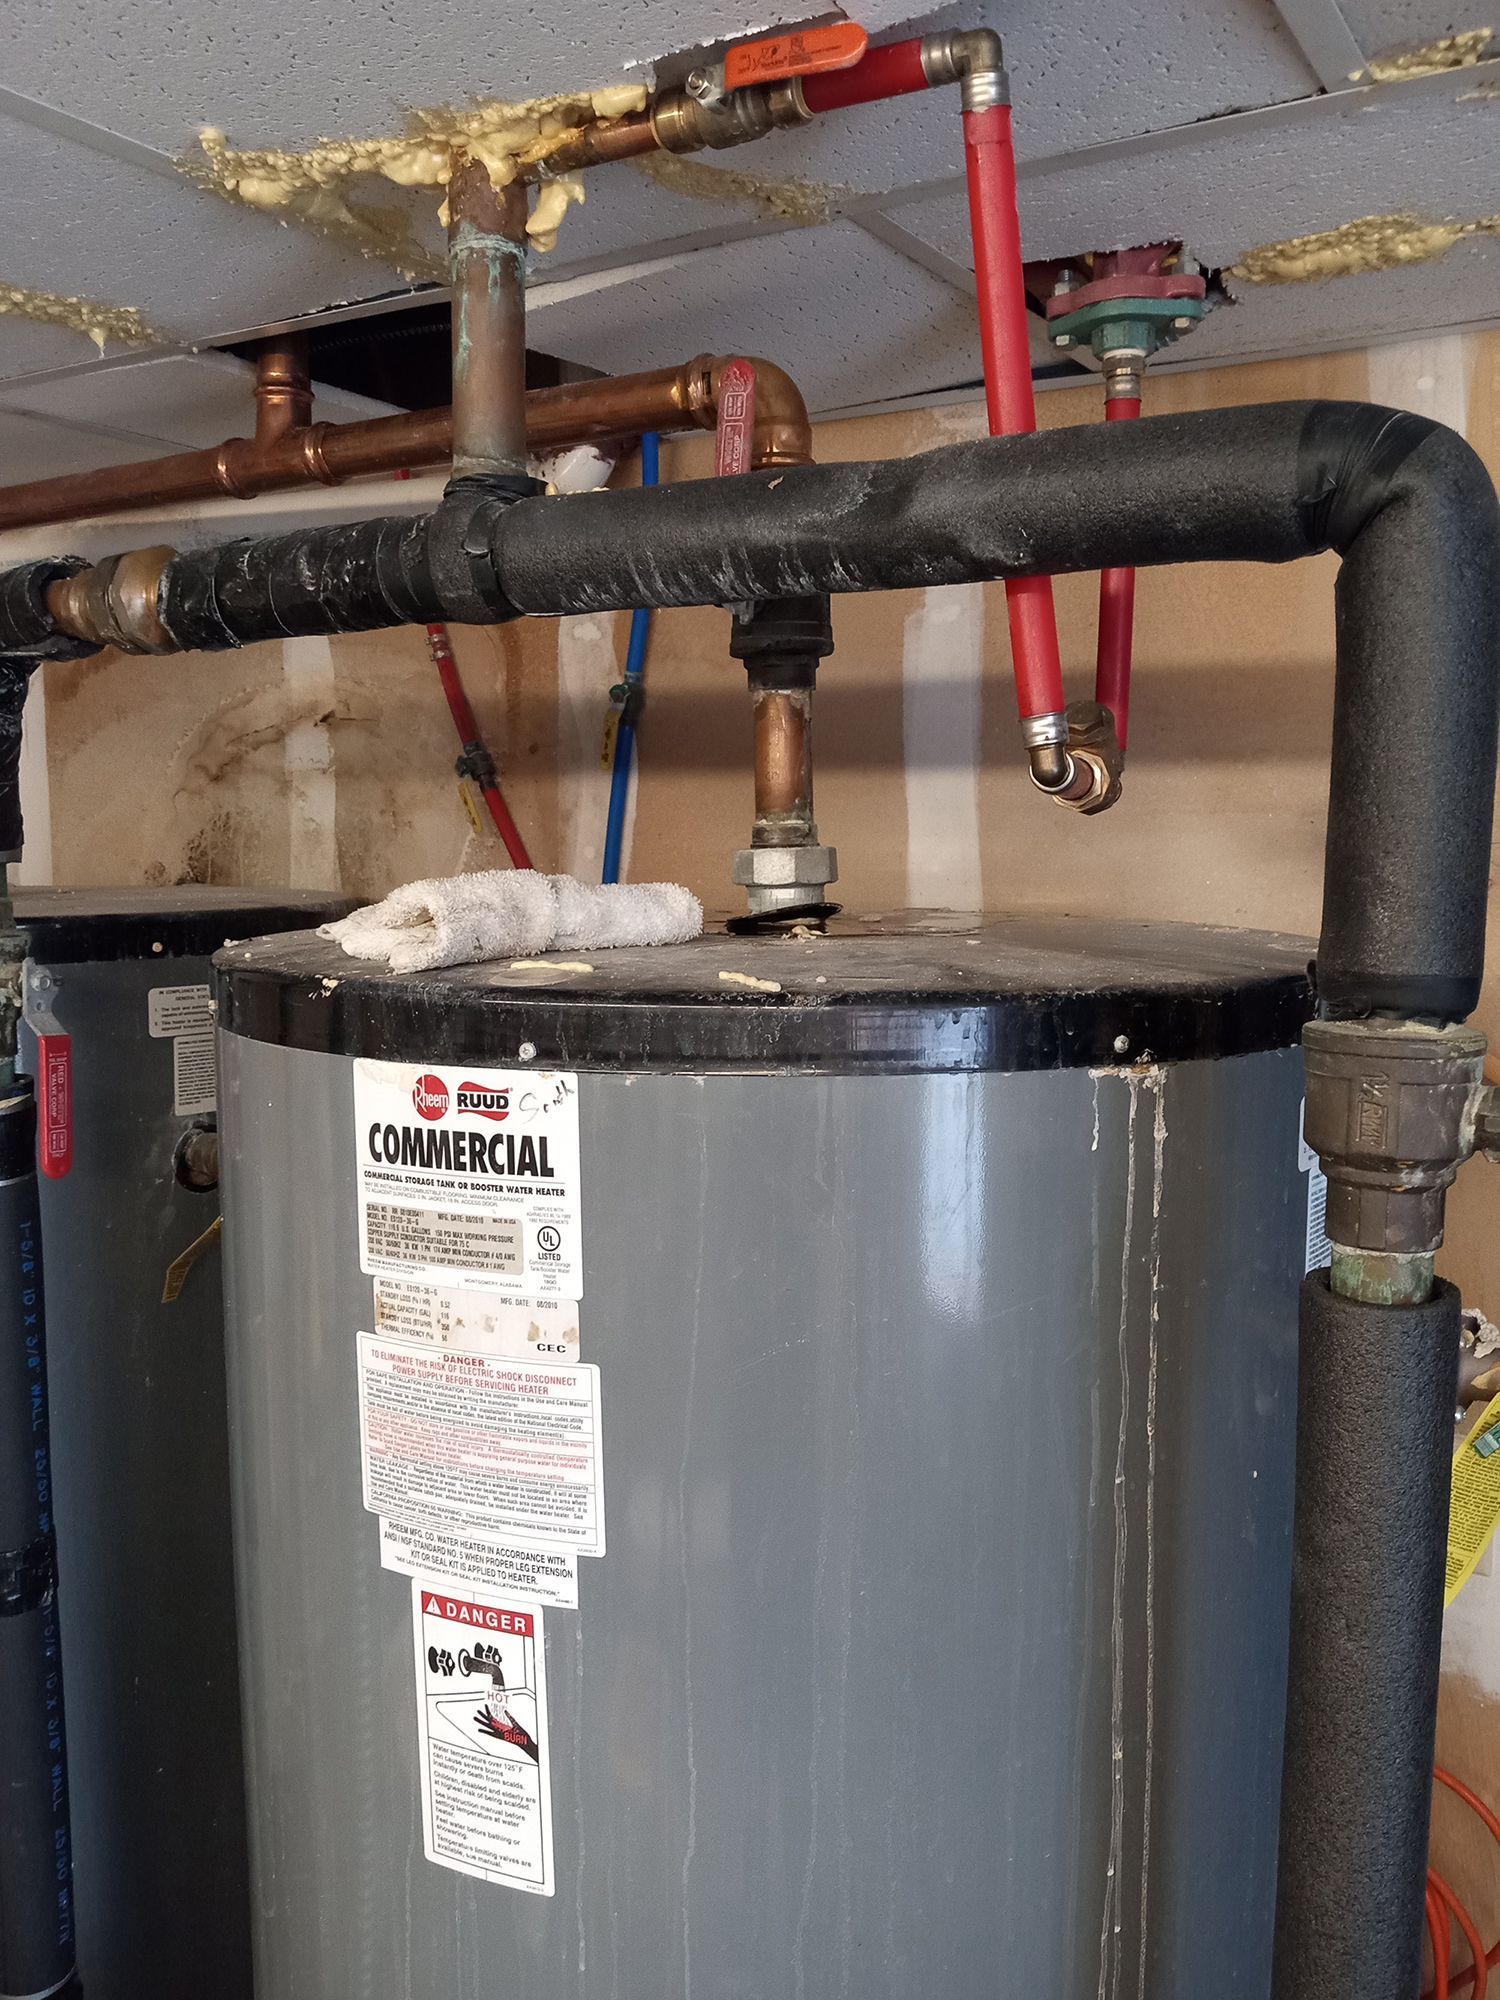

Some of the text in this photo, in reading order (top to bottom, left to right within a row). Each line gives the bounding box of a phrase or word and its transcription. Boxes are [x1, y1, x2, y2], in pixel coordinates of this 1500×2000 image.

[733, 434, 741, 459] CORP
[413, 1075, 509, 1112] Rheem RUUD
[369, 1122, 554, 1177] COMMERCIAL
[364, 1170, 565, 1197] COMMERCIAL STORAGE TANK OR BOOSTER WATER HEATER
[492, 1195, 524, 1203] CLEARANCE
[488, 1234, 514, 1243] PRESSURE
[456, 1258, 485, 1268] CONDUCTOR
[462, 1249, 490, 1258] CONDUCTOR
[538, 1253, 561, 1261] LISTED
[379, 1280, 394, 1289] MODEL
[23, 1289, 35, 1305] ID
[380, 1301, 418, 1314] ACTUAL CAPACITY
[500, 1297, 514, 1306] MFG.
[24, 1313, 37, 1325] X
[380, 1323, 401, 1333] THERMAL
[536, 1343, 566, 1353] CEC
[371, 1349, 577, 1386] TO ELIMINATE THE RISK OF ELECTRIC SHOCK DISCONNECT
[443, 1354, 485, 1367] DANGER
[388, 1374, 422, 1386] INSTALLATION
[434, 1383, 465, 1394] OPERATION
[492, 1392, 520, 1402] instructions
[392, 1364, 549, 1395] POWER SUPPLY BEFORE SERVICING HEATER
[31, 1383, 43, 1431] WALL
[384, 1531, 573, 1579] ANSI NSF STANDARD NO. 5 WHEN PROPER LEG EXTENSION
[389, 1521, 566, 1566] RHEEM MFG. CO. WATER HEATER IN ACCORDANCE WITH
[411, 1549, 538, 1585] KIT OR SEAL KIT IS APPLIED TO HEATER.
[415, 1562, 441, 1573] EXTENSION
[458, 1573, 471, 1581] SEAL
[482, 1579, 518, 1590] INSTALLATION
[445, 1602, 526, 1633] DANGER
[487, 1692, 510, 1704] HOT
[504, 1731, 527, 1745] BURN
[432, 1743, 449, 1753] Water
[450, 1749, 487, 1765] temperature
[433, 1751, 504, 1777] can cause severe burns
[52, 1764, 63, 1812] WALL
[467, 1770, 485, 1780] death
[485, 1775, 501, 1784] from
[441, 1782, 463, 1793] highest
[463, 1788, 476, 1797] risk
[476, 1792, 483, 1800] of
[484, 1794, 503, 1806] being
[461, 1779, 487, 1792] disabled
[488, 1787, 501, 1795] and
[502, 1790, 524, 1802] elderly
[434, 1790, 525, 1821] See instruction manual before
[456, 1805, 493, 1821] temperature
[502, 1819, 519, 1828] water
[436, 1815, 448, 1824] Feel
[449, 1820, 466, 1830] water
[467, 1826, 487, 1837] before
[487, 1831, 512, 1845] bathing
[437, 1833, 473, 1851] Temperature
[475, 1847, 498, 1860] limiting
[499, 1854, 519, 1865] valves
[477, 1856, 502, 1868] manual.
